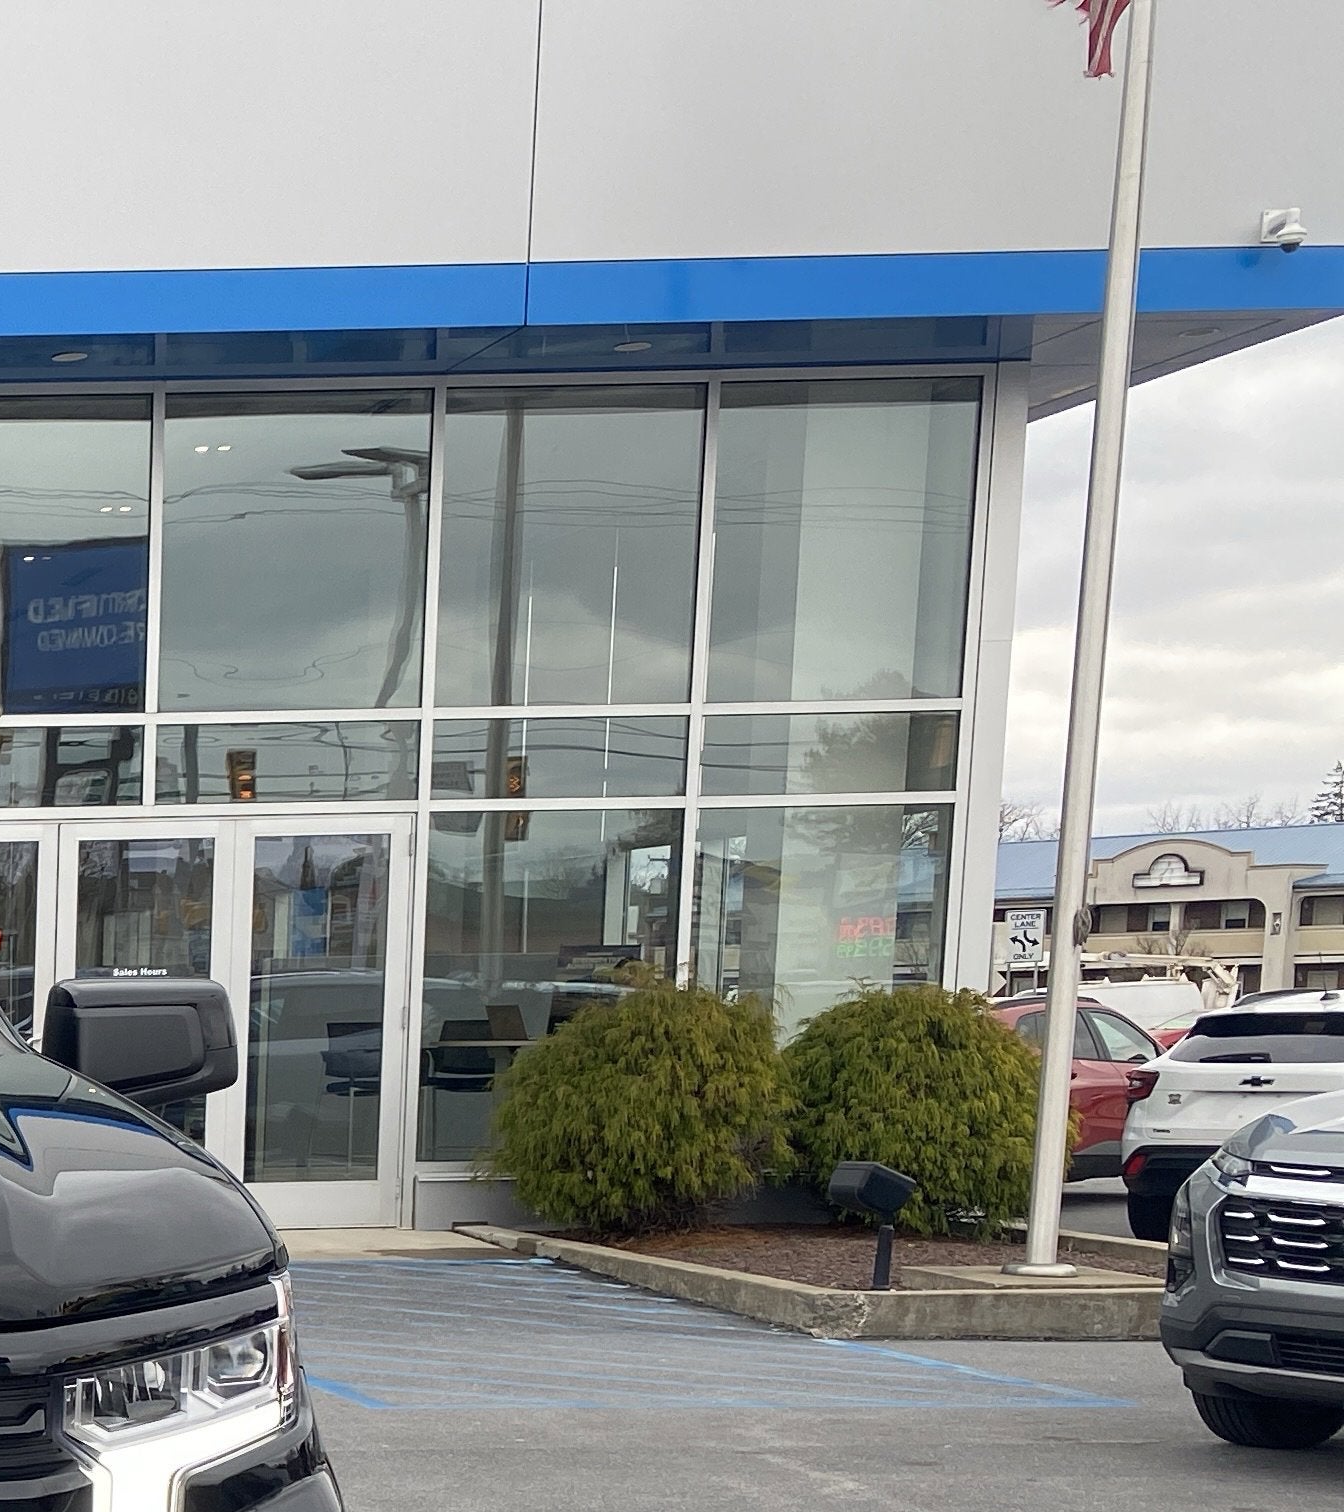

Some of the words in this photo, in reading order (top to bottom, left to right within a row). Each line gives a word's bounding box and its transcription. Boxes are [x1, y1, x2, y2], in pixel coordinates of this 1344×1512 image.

[1011, 913, 1042, 921] CENTER
[1014, 920, 1037, 928] LANE
[1013, 952, 1035, 960] ONLY
[113, 968, 138, 976] Sales
[140, 967, 168, 976] Hours
